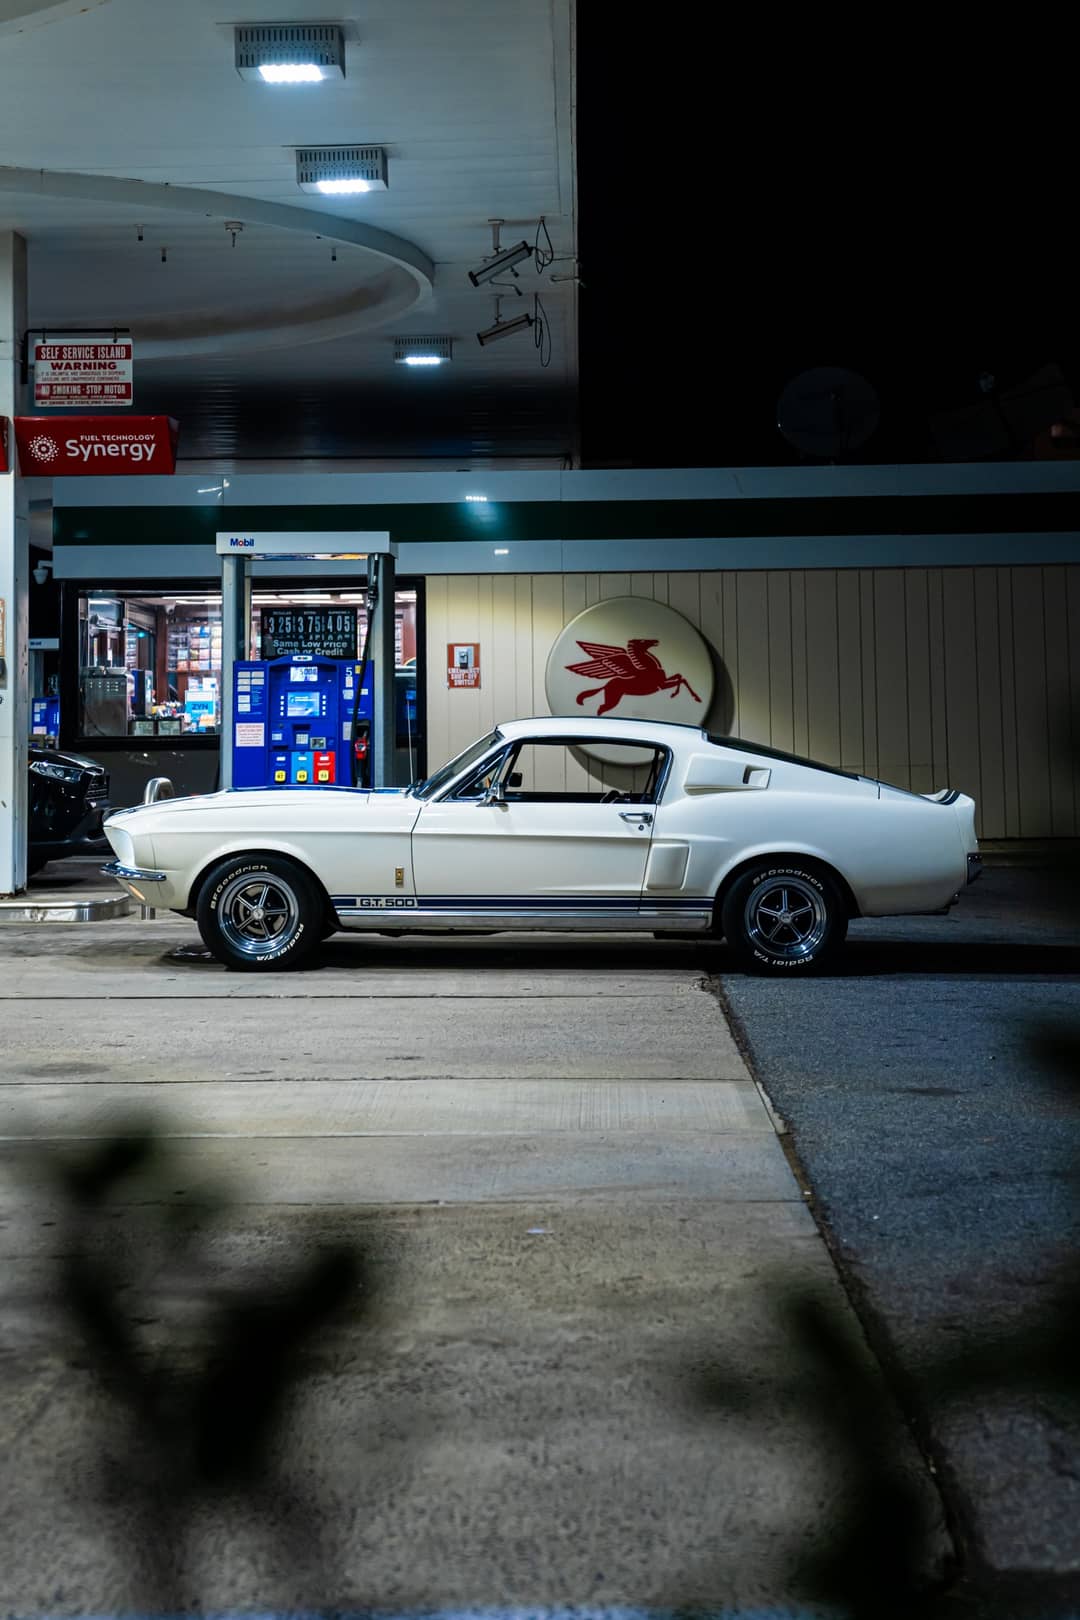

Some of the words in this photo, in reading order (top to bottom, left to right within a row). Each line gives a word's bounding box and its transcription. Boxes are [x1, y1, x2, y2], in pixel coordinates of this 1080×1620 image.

[41, 346, 60, 360] SELF
[62, 346, 94, 360] SERVICE
[98, 346, 126, 359] ISLAND
[51, 361, 117, 370] WARNING
[52, 385, 81, 395] SMOKING
[86, 385, 102, 395] STOP
[104, 385, 126, 395] MOTOR
[65, 439, 157, 462] Synergy
[230, 538, 254, 547] Mobil
[273, 639, 299, 648] Same
[301, 639, 321, 648] Low
[323, 640, 348, 648] Price
[276, 647, 300, 655] Cash
[314, 647, 344, 656] Credit
[345, 667, 353, 676] 5
